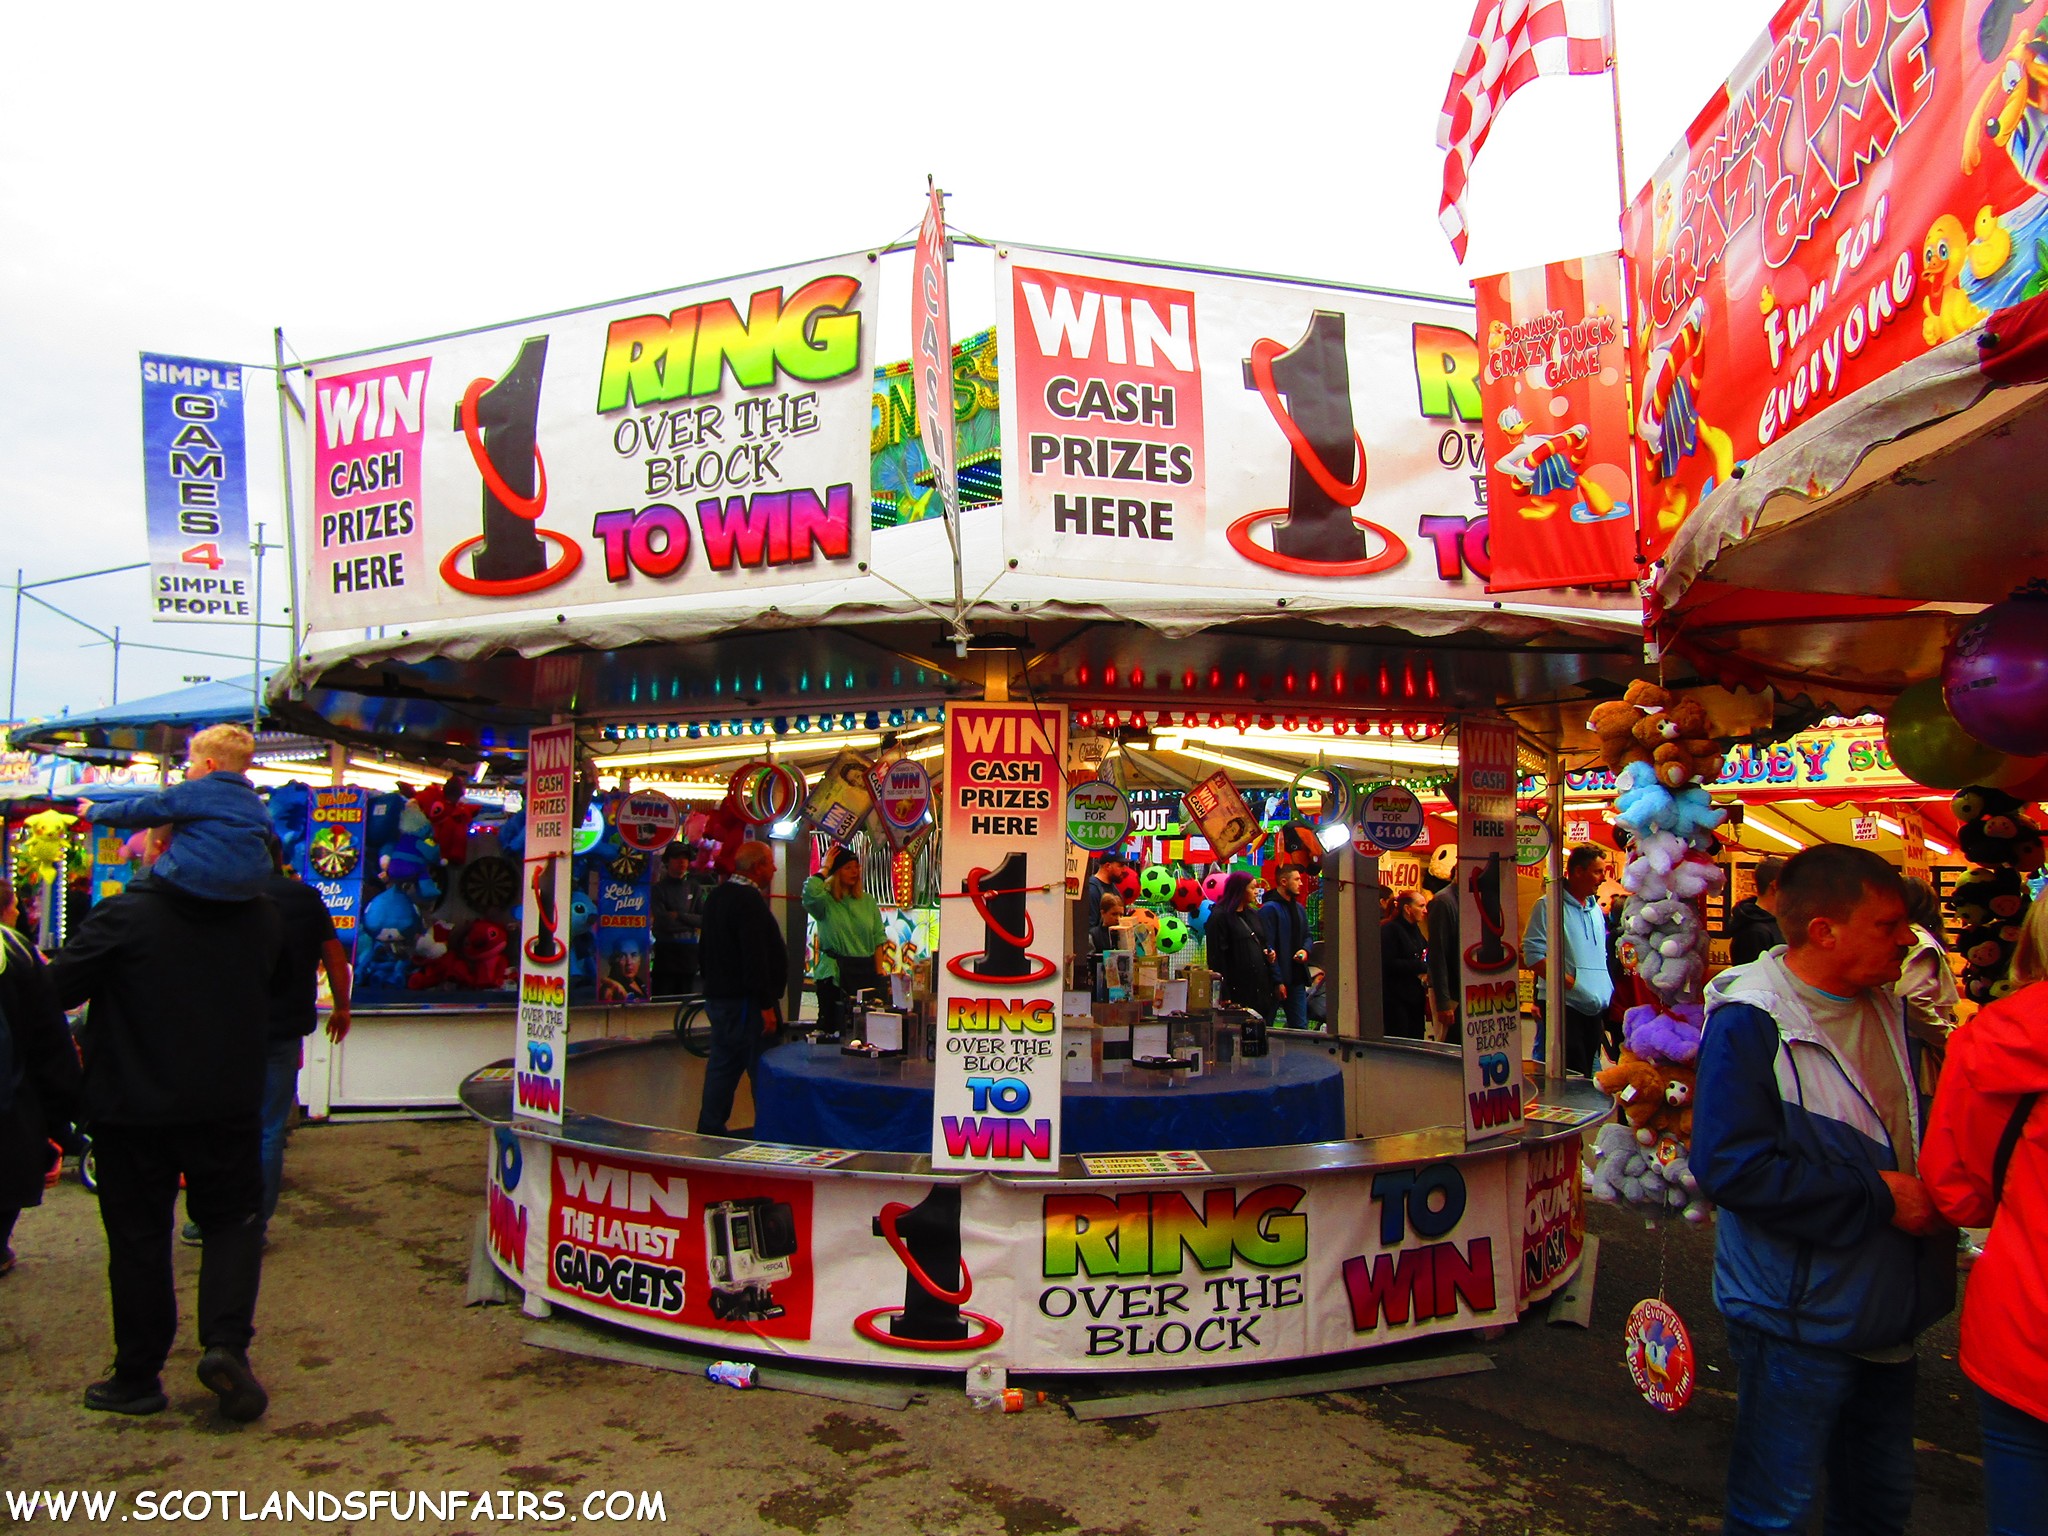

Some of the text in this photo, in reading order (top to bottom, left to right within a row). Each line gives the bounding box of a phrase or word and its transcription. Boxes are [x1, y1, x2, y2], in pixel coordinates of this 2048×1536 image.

[1762, 8, 1936, 268] GAME
[1651, 0, 1922, 328] CRAZY DU
[1764, 196, 1890, 369] Fun For
[597, 274, 863, 414] RING
[1021, 281, 1195, 373] WIN
[1504, 310, 1564, 346] DONALD'S
[1489, 316, 1615, 379] CRAZY DUCK
[1757, 247, 1917, 446] Everyone
[144, 361, 241, 392] SIMPLE
[922, 263, 946, 468] CASH
[1545, 348, 1600, 388] GAME
[318, 369, 425, 450] WIN
[1045, 377, 1174, 428] CASH
[613, 391, 820, 457] OVER THE
[171, 394, 225, 537] GAMES
[329, 451, 402, 498] CASH
[644, 441, 784, 495] BLOCK
[1030, 434, 1194, 485] PRIZES
[322, 500, 414, 548] PRIZES
[592, 503, 691, 584] TO
[696, 482, 854, 571] WIN
[1053, 494, 1174, 542] HERE
[181, 542, 224, 571] 4
[333, 553, 404, 593] HERE
[158, 575, 246, 597] SIMPLE
[158, 598, 250, 617] PEOPLE
[956, 716, 1056, 755] WIN
[1466, 729, 1513, 766] WIN
[532, 735, 570, 773] WIN
[970, 761, 1041, 782] CASH
[536, 775, 564, 794] CASH
[891, 773, 920, 789] WIN
[1472, 770, 1506, 790] CASH
[313, 808, 362, 823] OCHE!
[532, 798, 567, 816] PRIZES
[630, 800, 669, 819] WIN
[960, 789, 1050, 809] PRIZES
[1075, 795, 1118, 810] PLAY
[1190, 796, 1205, 816] CASH
[1198, 786, 1217, 810] WIN
[1373, 797, 1412, 812] PLAY
[1468, 794, 1510, 815] PRIZES
[536, 820, 562, 838] HERE
[822, 803, 847, 831] WIN
[837, 815, 856, 837] CASH
[971, 816, 1038, 836] HERE
[1077, 825, 1115, 838] £1.00
[1085, 812, 1106, 821] FOR
[1376, 826, 1411, 838] £1.00
[1382, 813, 1402, 822] FOR
[1473, 820, 1505, 837] HERE
[1516, 825, 1541, 836] LAY
[1517, 847, 1540, 857] 1.00
[604, 884, 634, 900] Lets
[1395, 864, 1419, 887] £10
[615, 895, 645, 912] play
[601, 915, 646, 928] DARTS!
[523, 973, 565, 1007] RING
[1465, 980, 1517, 1016] RING
[521, 1007, 564, 1025] OVER THE
[526, 1021, 556, 1039] BLOCK
[947, 997, 1055, 1033] RING
[1467, 1016, 1516, 1036] OVER THE
[527, 1040, 554, 1073] TO
[946, 1037, 1051, 1056] OVER THE
[1476, 1032, 1509, 1050] BLOCK
[963, 1055, 1033, 1073] BLOCK
[1478, 1052, 1509, 1087] TO
[517, 1071, 561, 1114] WIN
[966, 1077, 1031, 1112] TO
[1468, 1084, 1521, 1130] WIN
[941, 1116, 1051, 1159] WIN
[557, 1156, 689, 1219] WIN
[1370, 1162, 1467, 1246] TO
[1525, 1178, 1571, 1236] ORTUNE
[562, 1206, 679, 1259] THE LATEST
[1042, 1183, 1308, 1277] RING
[554, 1244, 685, 1313] GADGETS
[1343, 1237, 1496, 1332] WIN
[1038, 1274, 1304, 1319] OVER THE
[1084, 1314, 1261, 1356] BLOCK
[1644, 1302, 1668, 1325] Every
[1668, 1316, 1686, 1352] Time
[1629, 1356, 1648, 1391] Prize
[1649, 1384, 1673, 1405] Every
